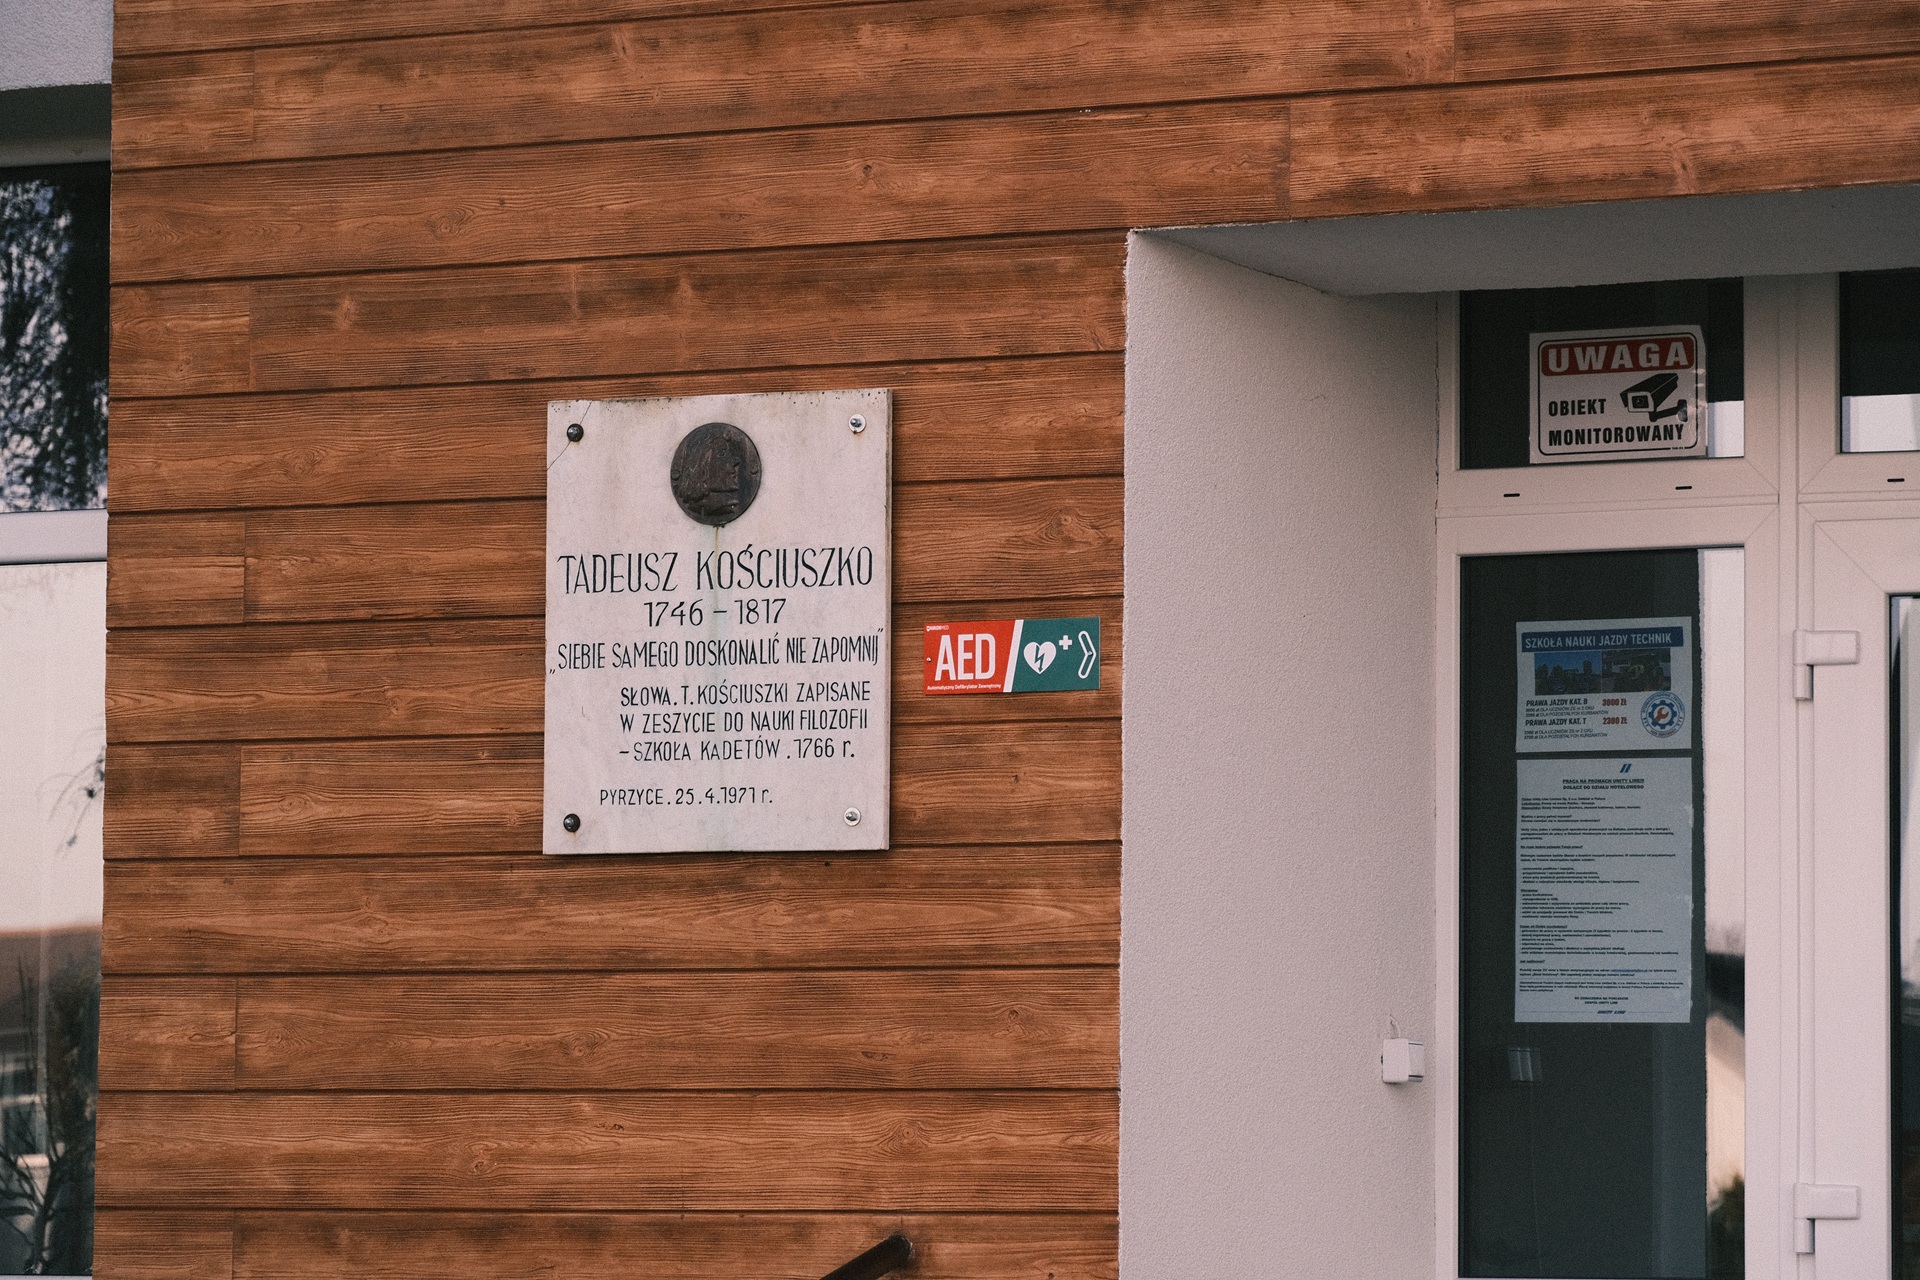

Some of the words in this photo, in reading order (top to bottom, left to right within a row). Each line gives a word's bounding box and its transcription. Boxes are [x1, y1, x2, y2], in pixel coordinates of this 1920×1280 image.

[1549, 341, 1688, 372] UWAGA
[1549, 399, 1606, 416] OBIEKT
[1549, 424, 1684, 446] MONITOROWANY
[557, 552, 678, 594] TADEUSZ
[697, 544, 873, 590] KOŚCIUSZKO
[644, 599, 703, 627] 1746
[735, 599, 786, 624] 1817
[612, 640, 678, 668] SAMEGO
[685, 633, 779, 666] DOSKONALIĆ
[786, 637, 807, 663] NIE
[1525, 637, 1563, 648] SZKOŁA
[1566, 635, 1596, 647] NAUKI
[1599, 635, 1628, 646] JAZDY
[1631, 633, 1671, 644] TECHNIK
[935, 633, 996, 681] AED
[621, 687, 677, 707] SŁOWA.
[796, 681, 871, 702] ZAPISANE
[621, 714, 634, 733] W
[642, 713, 715, 733] ZESZYCIE
[724, 712, 743, 731] DO
[751, 711, 794, 731] NAUKI
[800, 709, 868, 730] FILOZOFII
[843, 740, 855, 757] r.
[762, 788, 772, 803] r.
